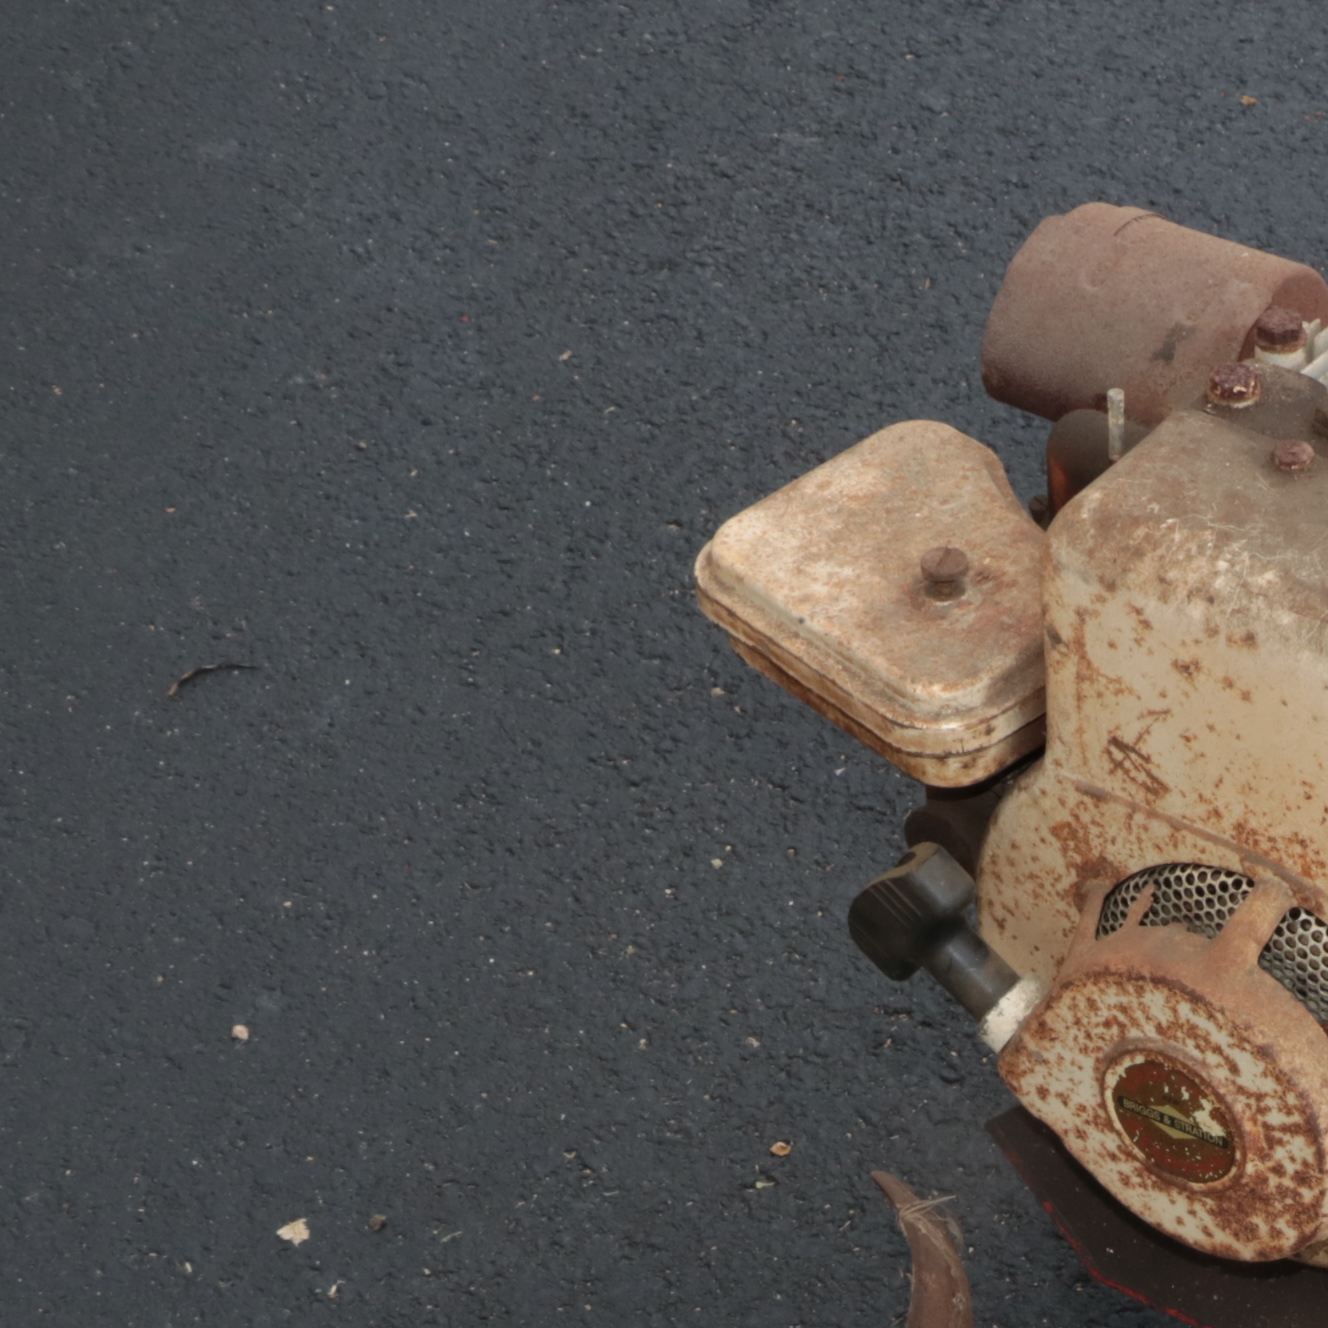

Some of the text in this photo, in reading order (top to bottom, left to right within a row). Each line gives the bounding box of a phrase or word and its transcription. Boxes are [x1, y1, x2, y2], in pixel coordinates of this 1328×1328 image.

[1122, 1098, 1161, 1121] BRIGGS
[1163, 1115, 1171, 1125] &
[1174, 1119, 1224, 1146] STRATTON
